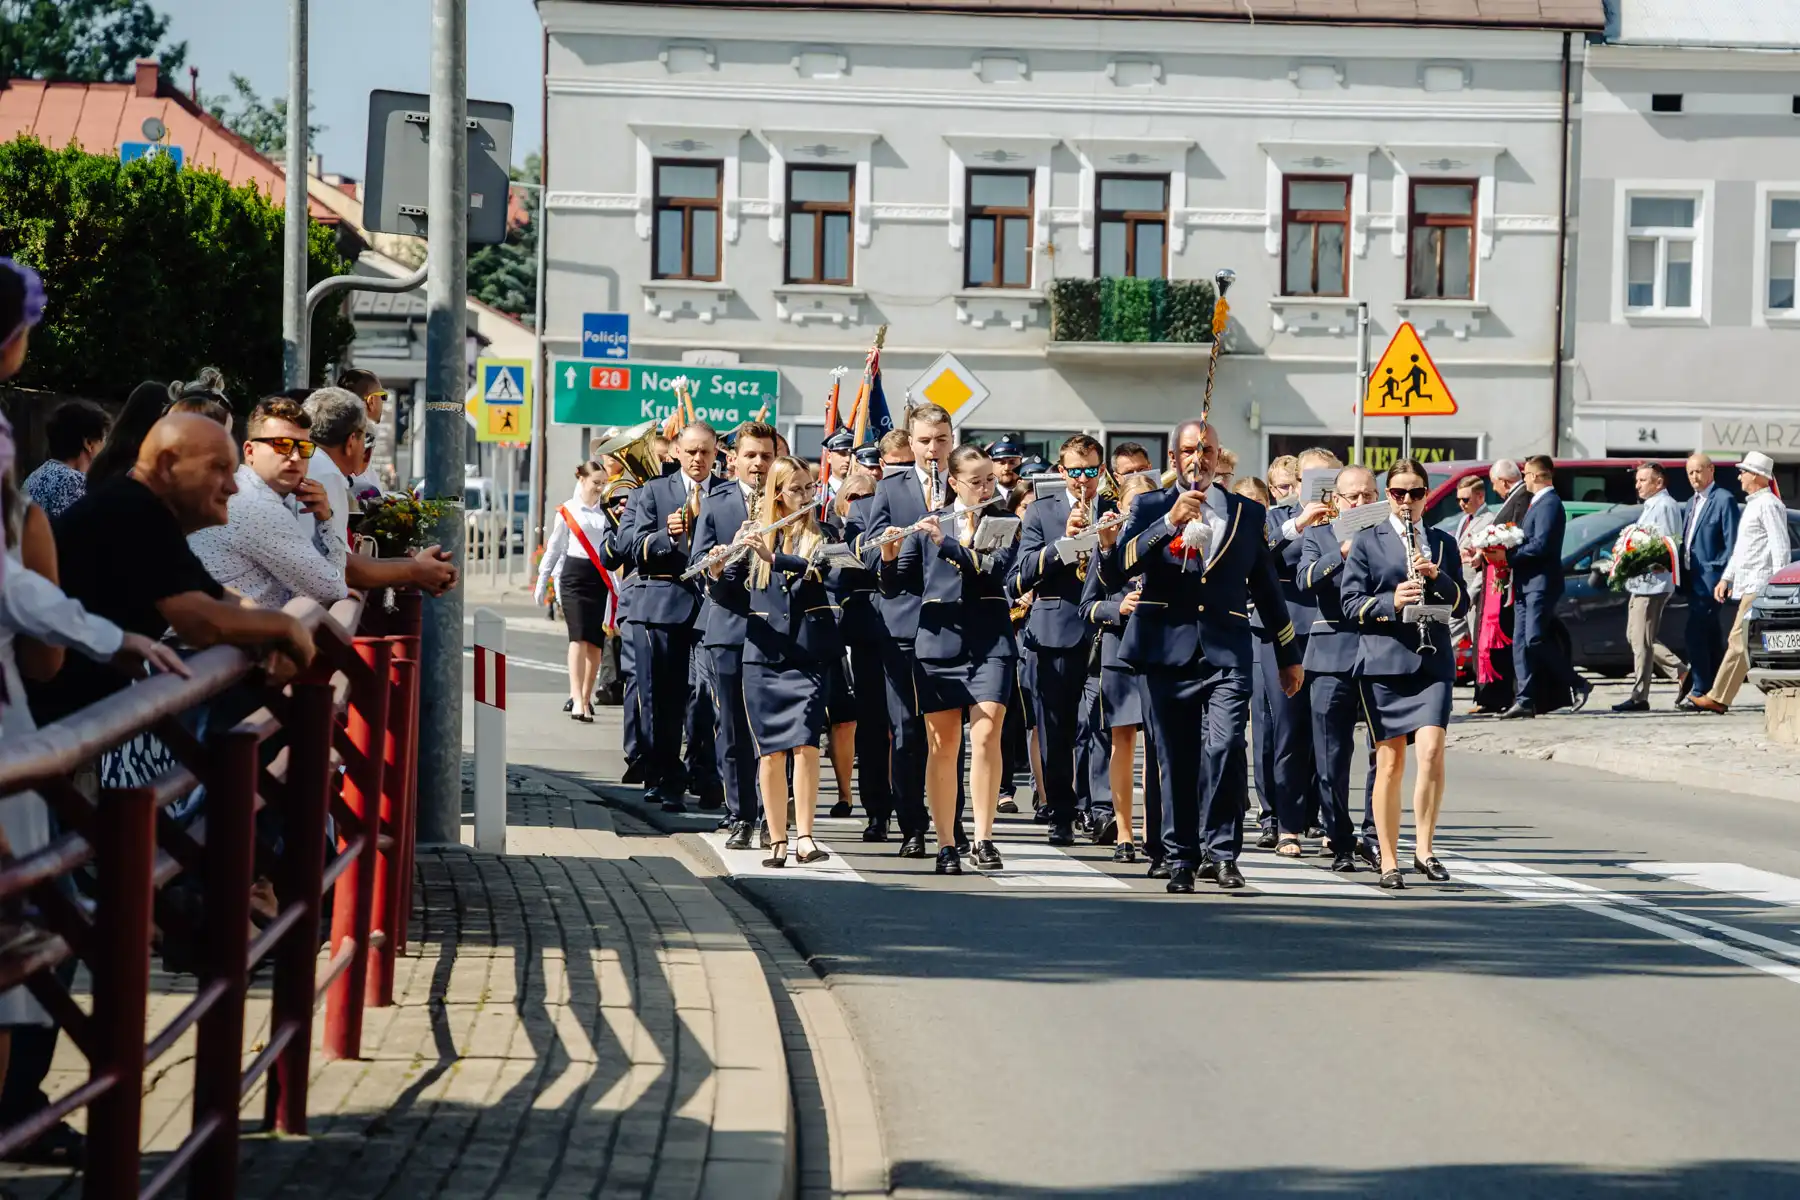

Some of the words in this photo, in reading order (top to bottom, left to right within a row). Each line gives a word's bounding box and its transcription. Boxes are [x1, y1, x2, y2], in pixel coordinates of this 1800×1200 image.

[584, 330, 628, 346] Policja
[599, 370, 621, 387] 28
[641, 371, 701, 398] Noy
[710, 375, 760, 399] Sącz
[641, 399, 739, 422] Kruowa
[1638, 427, 1659, 443] 24
[1712, 423, 1800, 448] WARZ
[1767, 635, 1783, 648] KNS
